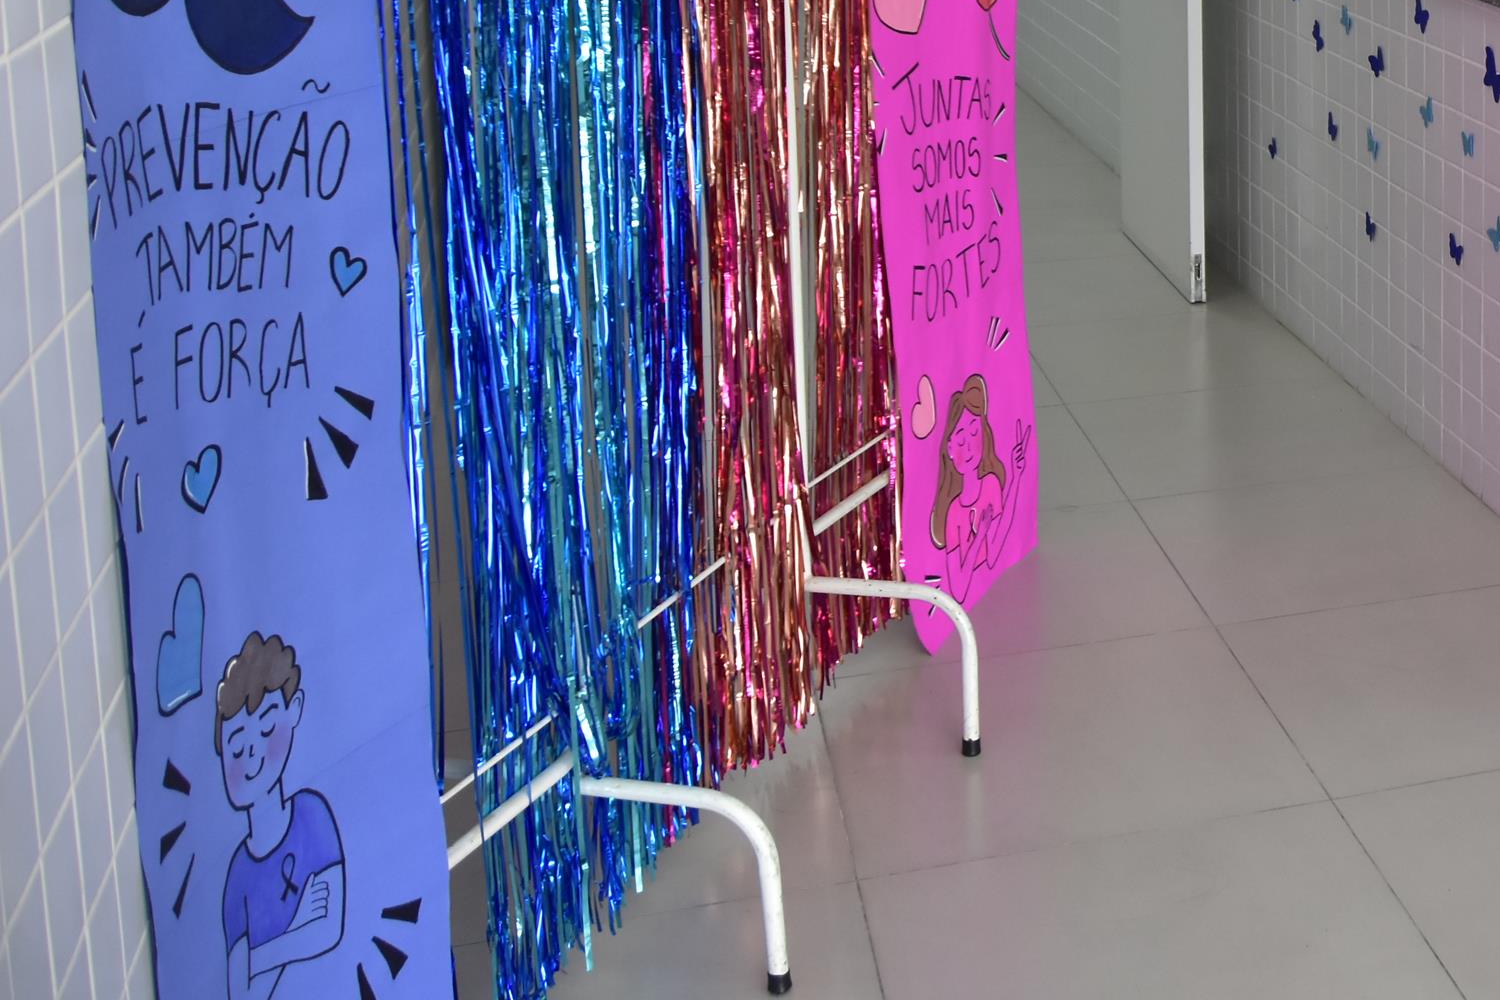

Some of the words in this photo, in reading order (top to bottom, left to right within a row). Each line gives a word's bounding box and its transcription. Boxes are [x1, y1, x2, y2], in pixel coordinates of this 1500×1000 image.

[892, 61, 993, 136] JUNTAS
[101, 78, 350, 231] PREVENÇÃO
[911, 136, 981, 193] SOMOS
[136, 212, 294, 306] TAMBÉM
[924, 189, 975, 247] MAIS
[911, 220, 1002, 323] FORTES
[130, 310, 148, 425] É
[173, 311, 311, 409] FORÇA
